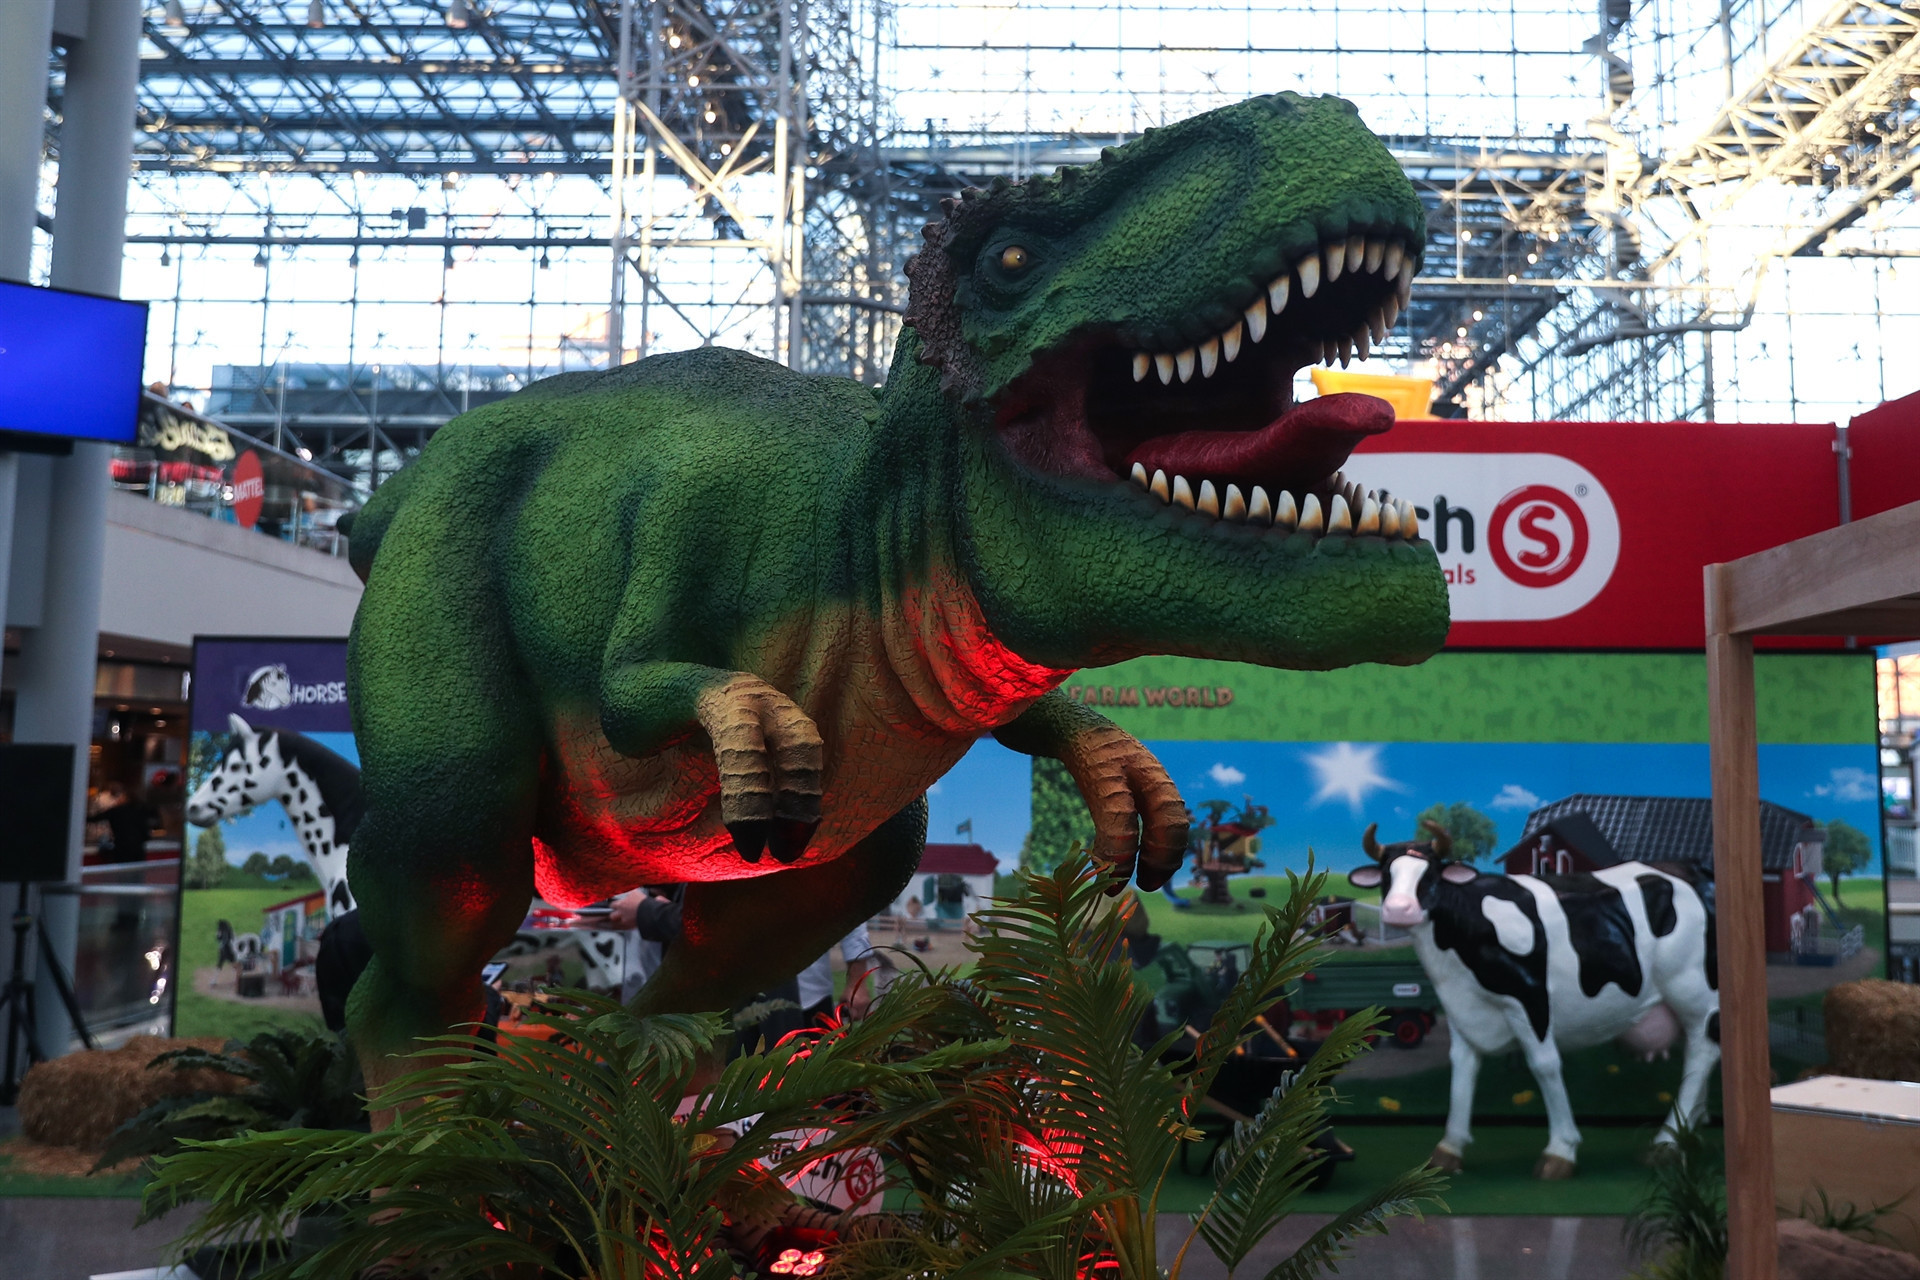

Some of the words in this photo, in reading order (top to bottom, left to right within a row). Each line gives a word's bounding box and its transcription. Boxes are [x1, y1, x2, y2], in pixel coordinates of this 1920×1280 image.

[234, 477, 264, 502] MATTEL
[292, 682, 348, 704] HORSE
[1069, 686, 1140, 706] FARM
[1143, 686, 1235, 708] WORLD
